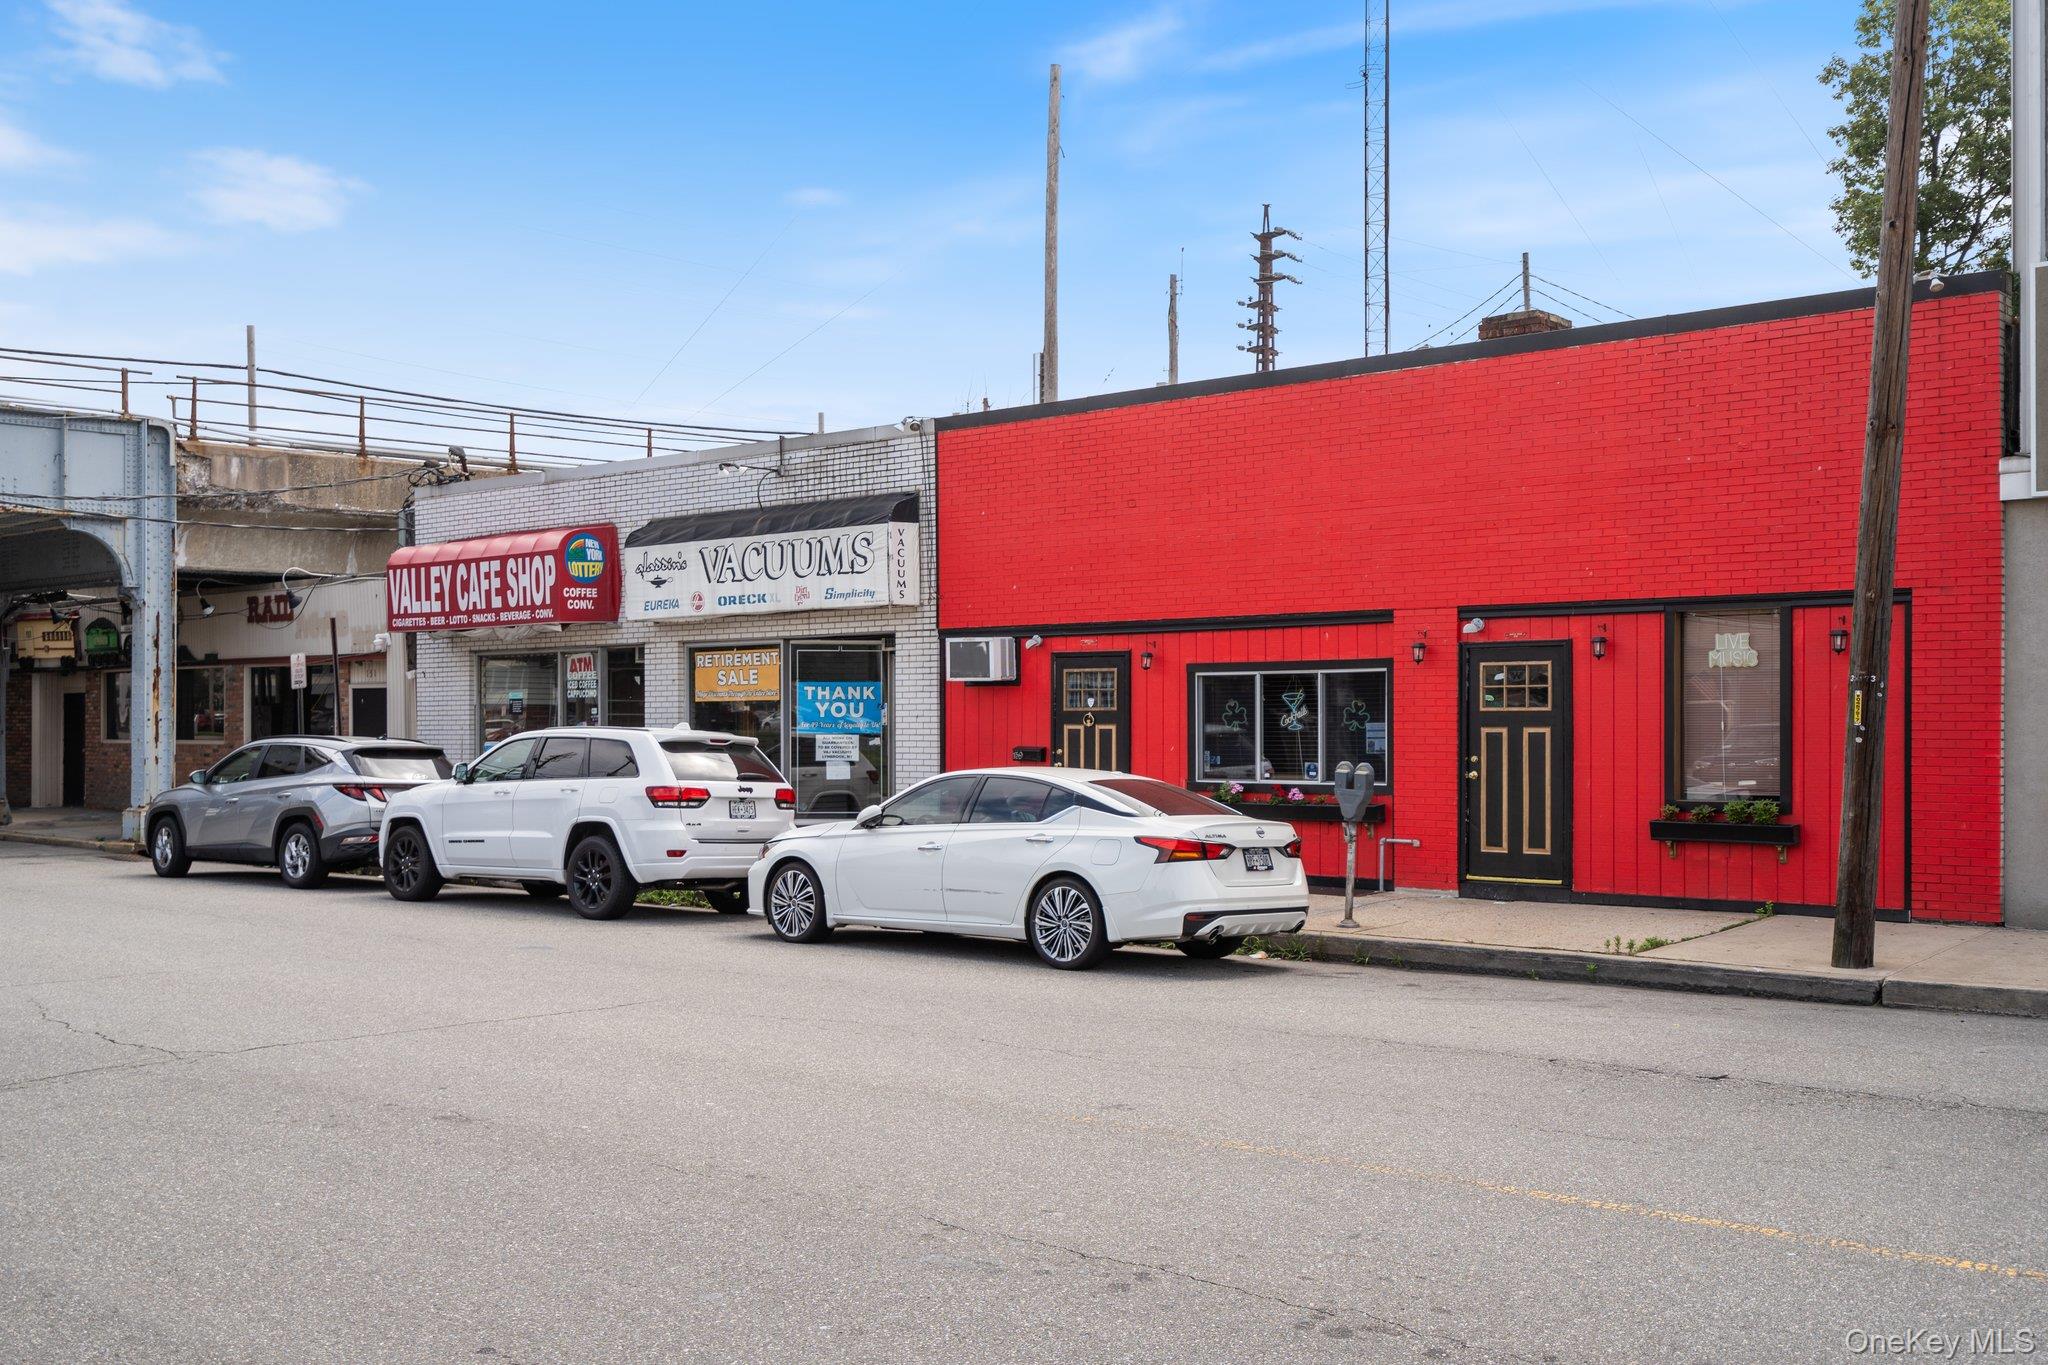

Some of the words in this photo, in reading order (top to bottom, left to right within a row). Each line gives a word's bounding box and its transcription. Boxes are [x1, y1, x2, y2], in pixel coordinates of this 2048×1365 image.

[585, 538, 600, 549] NEW
[586, 548, 603, 561] YORK
[698, 531, 876, 584] VACUUMS
[568, 561, 604, 577] LOTTERY
[896, 528, 907, 599] VACUUMS
[388, 565, 453, 614] VALLEY
[456, 561, 502, 612] CAFE
[506, 554, 556, 608] SHOP
[563, 587, 598, 598] COFFEE
[717, 593, 767, 607] ORECK
[824, 587, 876, 600] Simplicity
[567, 599, 595, 610] CONV.
[644, 598, 680, 612] EUREKA
[392, 617, 426, 628] CIGARETTES
[430, 616, 446, 626] BEER
[449, 614, 468, 625] LOTTO
[472, 612, 496, 623] SNACKS
[500, 610, 532, 621] BEVERAGE
[535, 608, 554, 619] CONV.
[1715, 633, 1750, 650] LIVE
[569, 656, 593, 672] ATM
[696, 653, 779, 668] RETIREMENT
[1709, 650, 1759, 668] MUSIC
[567, 671, 597, 680] COFFEE
[717, 669, 759, 686] SALE
[567, 680, 578, 689] ICED
[579, 680, 597, 689] COFFEE
[803, 685, 875, 701] THANK
[815, 701, 864, 718] YOU
[737, 785, 753, 794] Jeep
